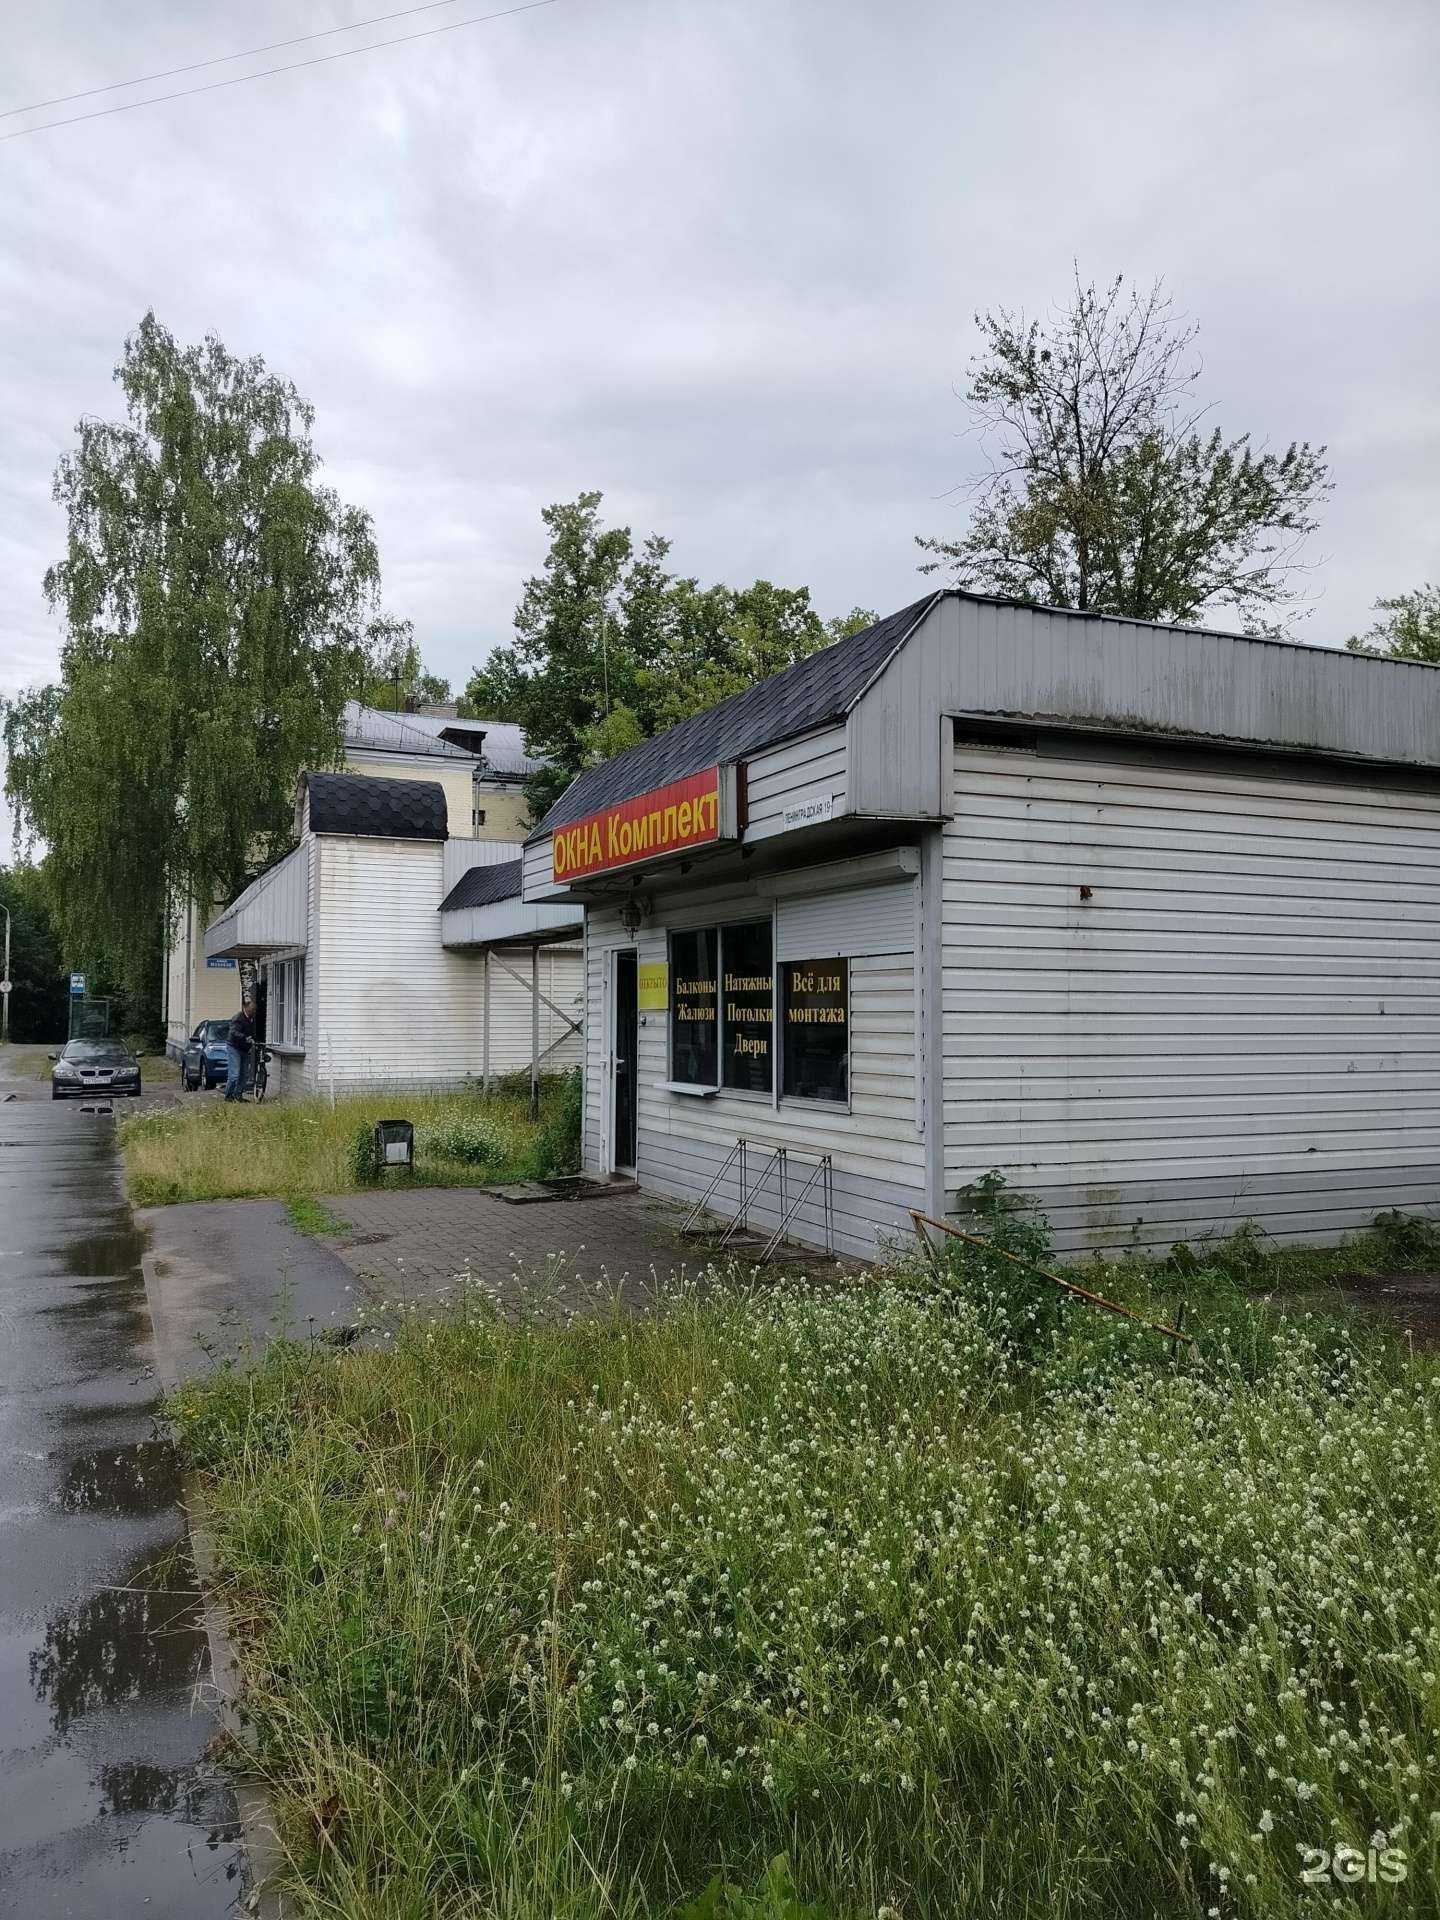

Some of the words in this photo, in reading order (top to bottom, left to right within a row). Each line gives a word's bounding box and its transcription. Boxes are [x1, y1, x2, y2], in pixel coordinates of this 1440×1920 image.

[553, 821, 603, 874] ОКНА
[608, 791, 719, 858] Комплект
[676, 977, 717, 994] Балконы
[792, 972, 814, 992] Всё
[816, 976, 841, 995] для
[677, 1003, 715, 1020] Жалюзи
[727, 1003, 775, 1021] Потолки
[788, 1007, 845, 1023] монтажа
[734, 1033, 768, 1059] Двери
